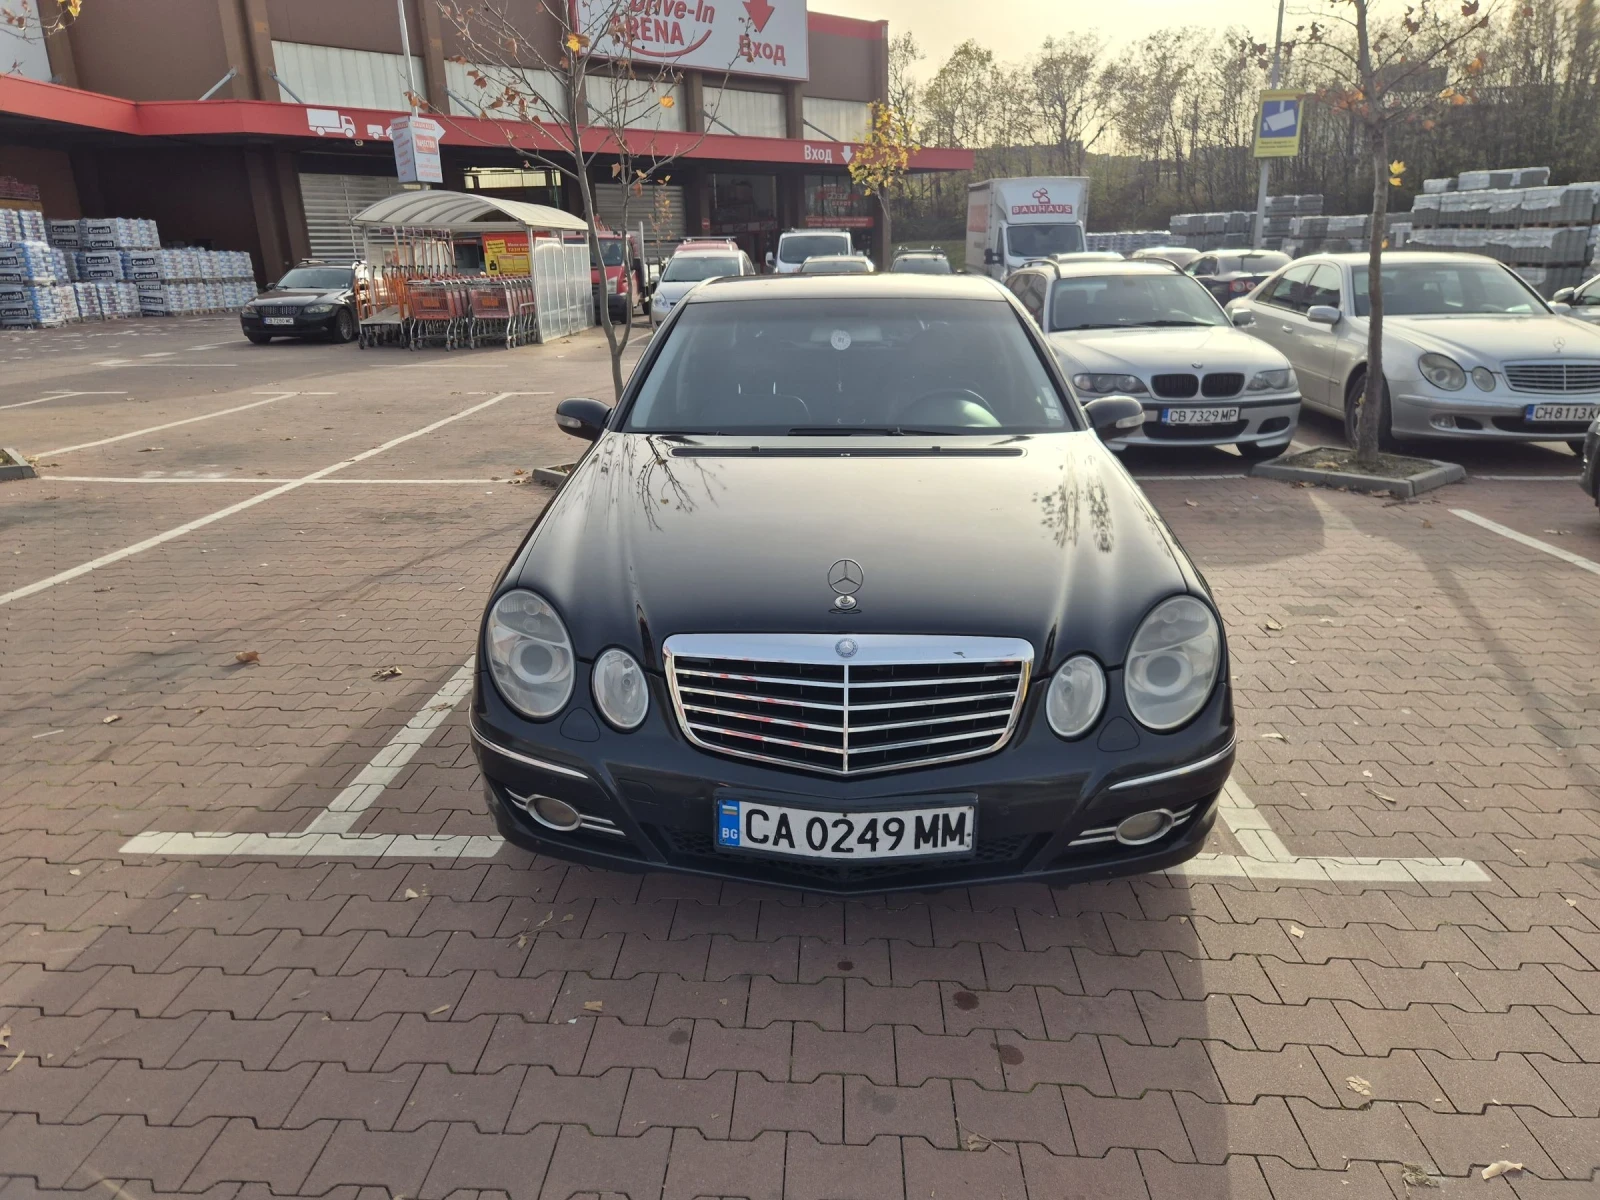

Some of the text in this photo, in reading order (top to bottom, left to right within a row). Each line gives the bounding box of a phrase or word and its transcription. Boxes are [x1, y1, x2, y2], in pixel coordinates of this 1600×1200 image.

[739, 34, 786, 66] Вход
[804, 145, 832, 163] Вход
[1012, 205, 1072, 214] BAUHAUS
[1, 308, 28, 316] Ceresit
[1170, 409, 1237, 422] CB 7329 MP
[1535, 407, 1553, 419] CH
[1555, 407, 1586, 419] 8113
[722, 827, 738, 840] BG
[745, 808, 967, 853] CA 0249 MM
